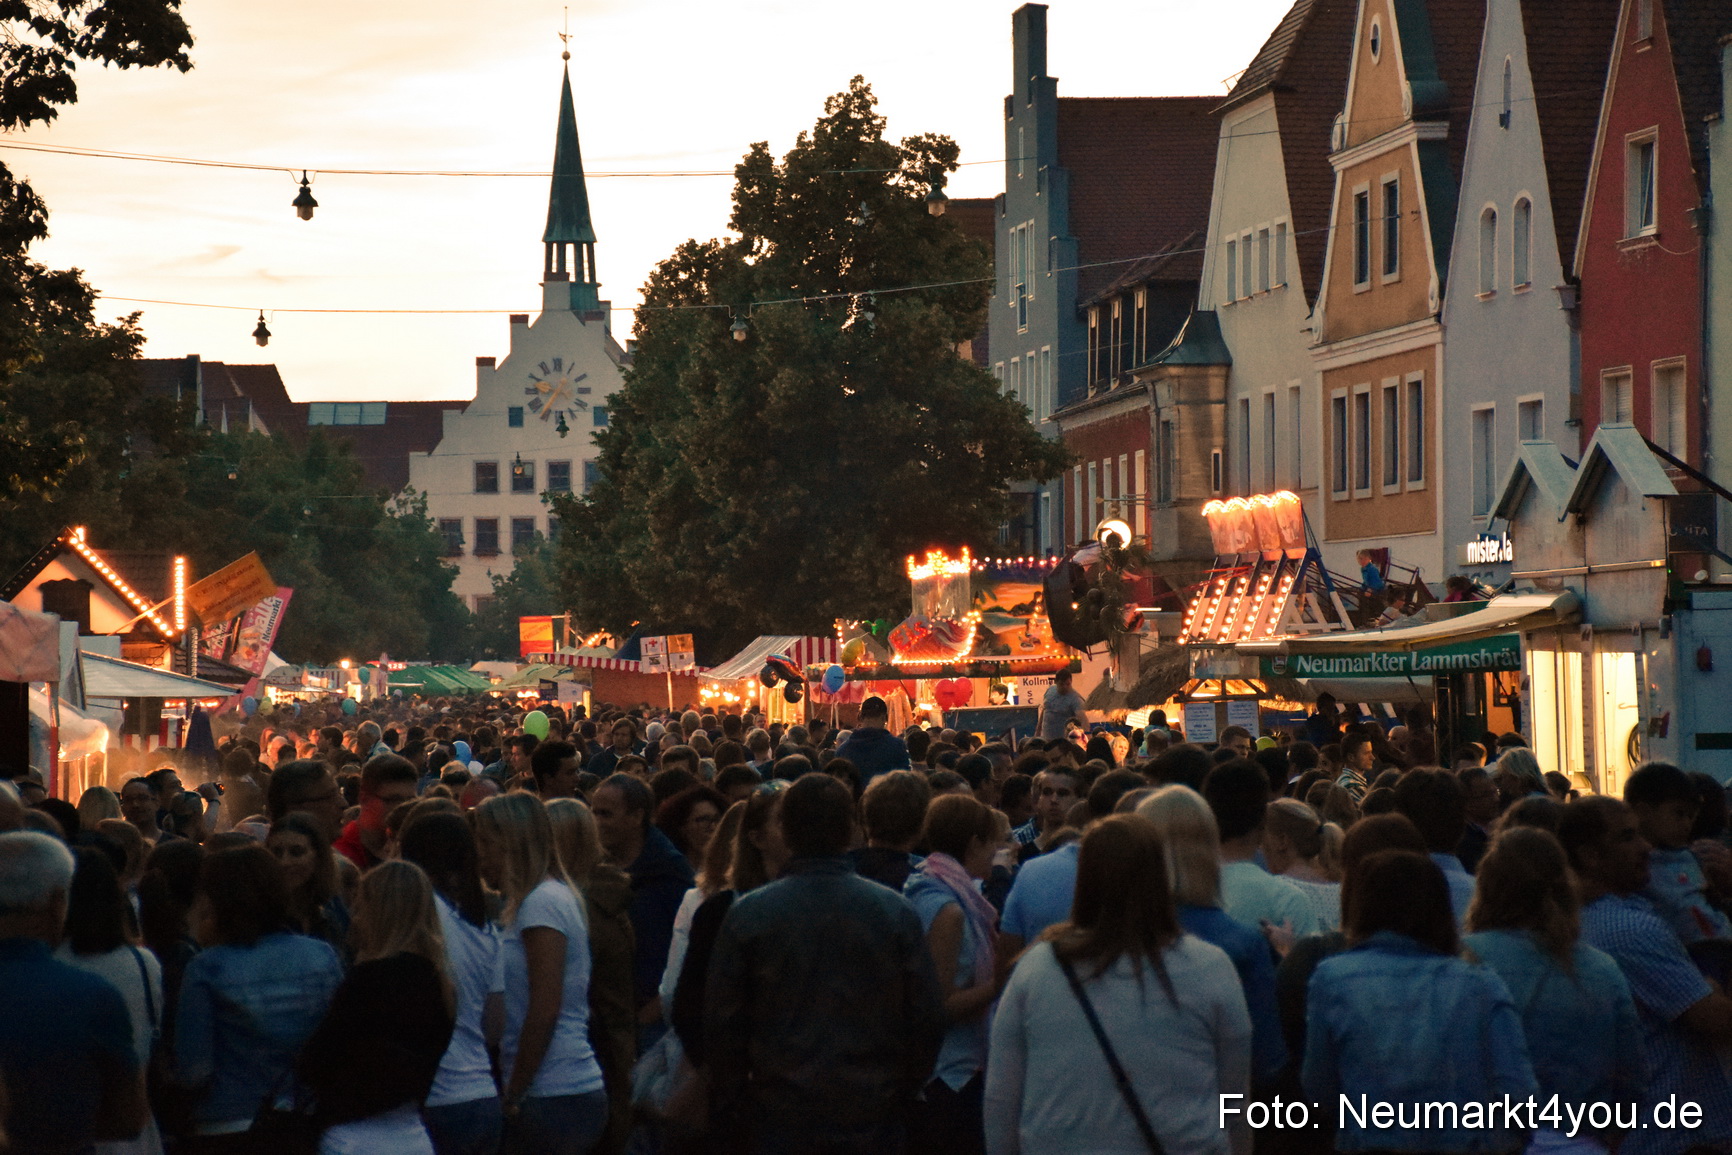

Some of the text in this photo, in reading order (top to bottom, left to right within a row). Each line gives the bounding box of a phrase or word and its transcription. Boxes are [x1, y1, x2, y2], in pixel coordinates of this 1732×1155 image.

[1467, 533, 1500, 563] mister
[261, 600, 282, 642] Neumarkt
[1296, 653, 1407, 673] Neumarkter
